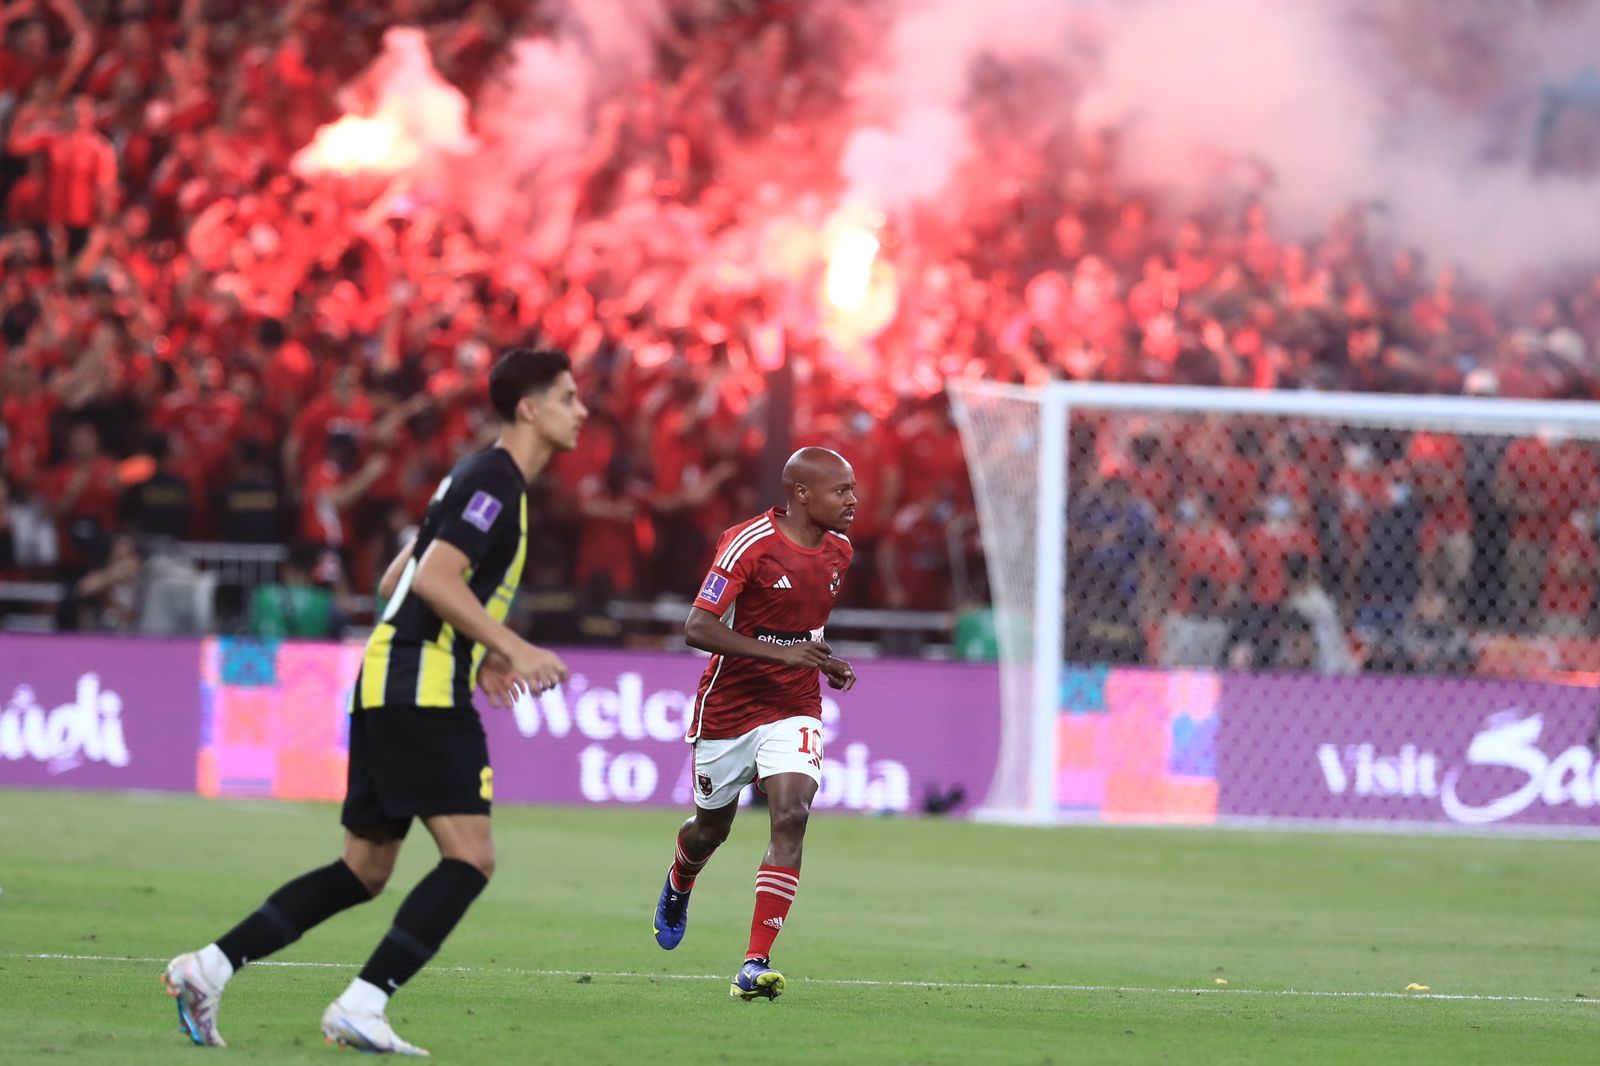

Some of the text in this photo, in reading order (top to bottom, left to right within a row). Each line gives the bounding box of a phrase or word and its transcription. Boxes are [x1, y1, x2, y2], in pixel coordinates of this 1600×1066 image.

[757, 634, 808, 647] etisal
[798, 727, 823, 761] 10
[1317, 708, 1600, 824] Visit Sa
[579, 744, 658, 802] to
